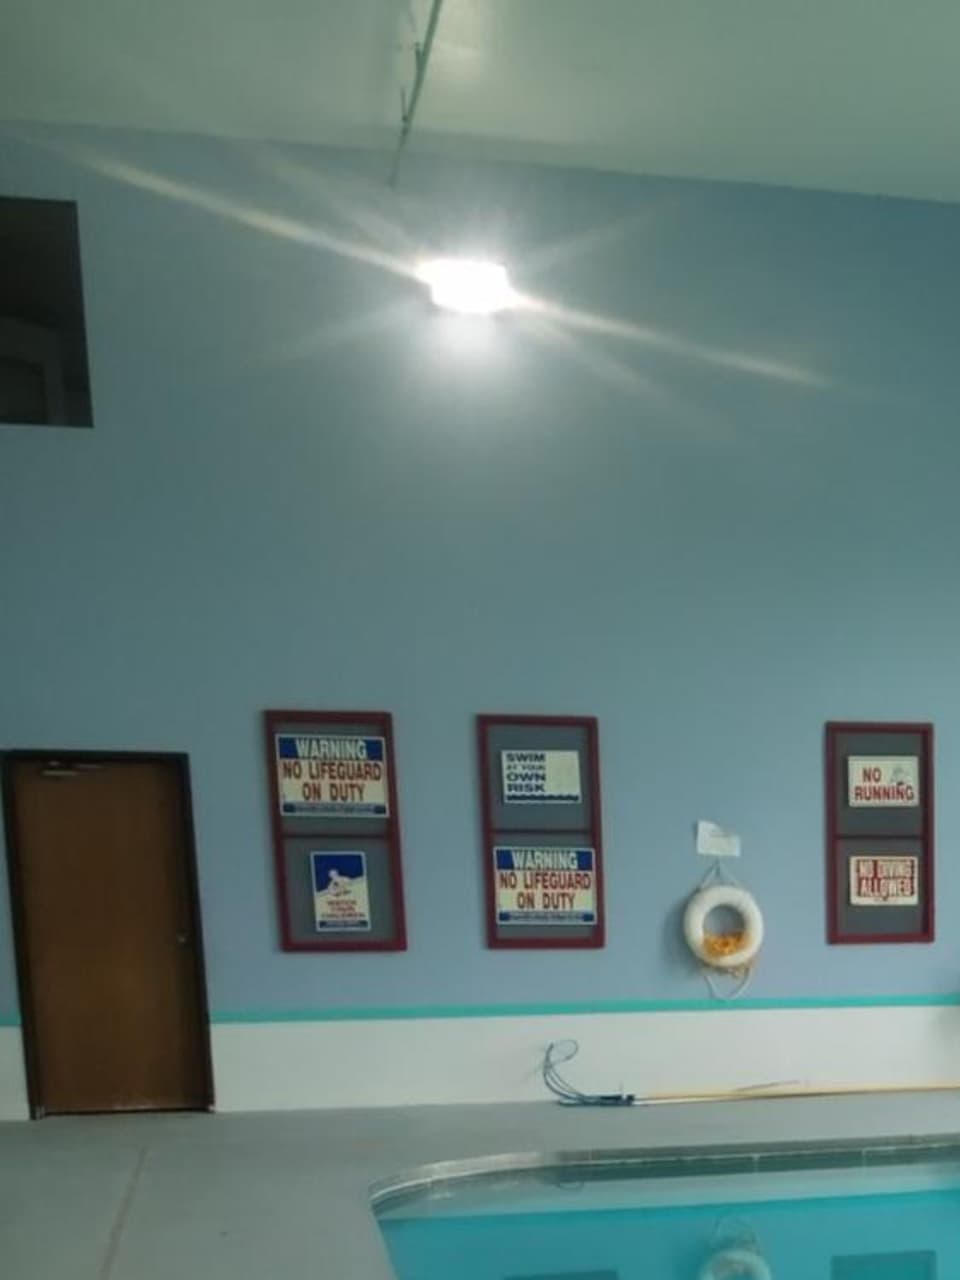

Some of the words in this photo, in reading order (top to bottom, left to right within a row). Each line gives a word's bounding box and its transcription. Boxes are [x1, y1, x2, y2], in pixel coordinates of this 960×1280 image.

[295, 738, 367, 760] WARNING
[507, 752, 545, 762] SWIM
[283, 762, 302, 779] NO
[309, 762, 381, 781] LIFEGUARD
[506, 772, 546, 782] OWN
[862, 767, 881, 782] NO
[302, 783, 321, 800] ON
[329, 783, 365, 801] DUTY
[507, 783, 545, 792] RISK
[855, 785, 914, 800] RUNNING
[512, 850, 578, 870] WARNING
[860, 861, 873, 877] NO
[500, 872, 517, 888] NO
[524, 872, 591, 890] LIFEGUARD
[860, 878, 911, 896] ALLOWED
[517, 892, 535, 908] ON
[542, 892, 576, 909] DUTY
